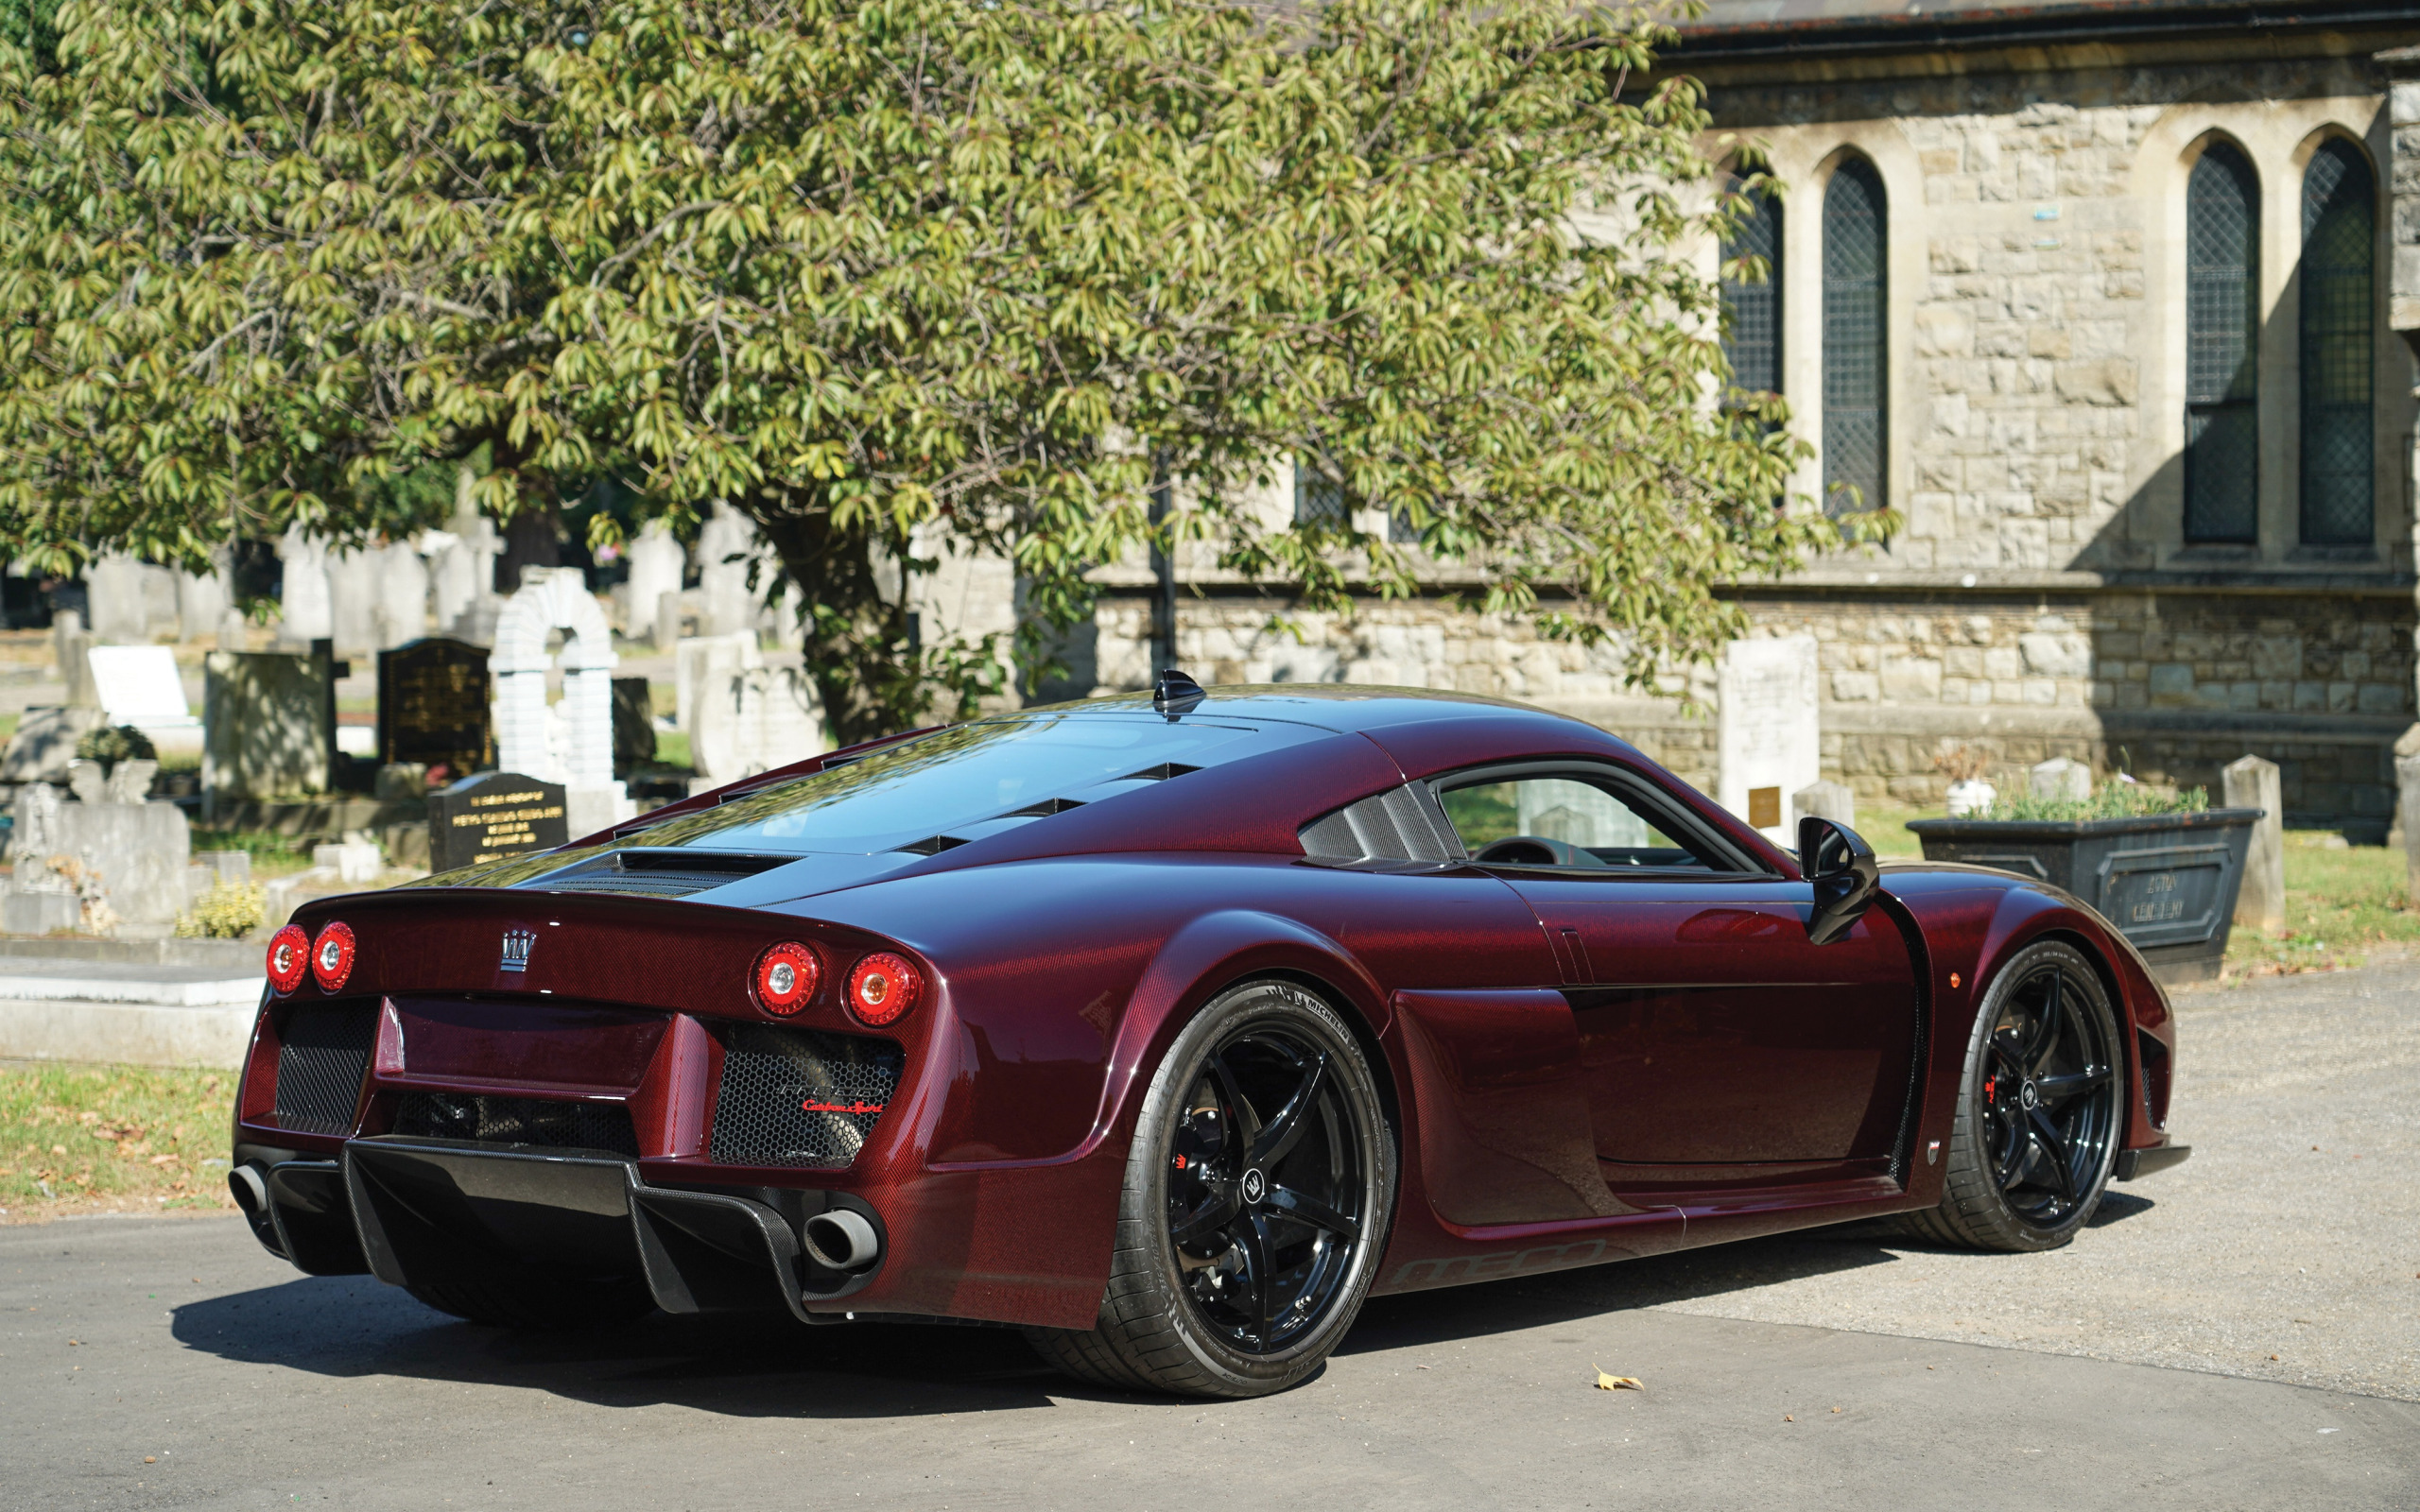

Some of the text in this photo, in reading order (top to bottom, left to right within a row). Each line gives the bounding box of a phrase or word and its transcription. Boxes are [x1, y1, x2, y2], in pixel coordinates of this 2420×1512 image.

[1308, 999, 1350, 1040] MICHELIN
[803, 1099, 884, 1115] Carbon Sport
